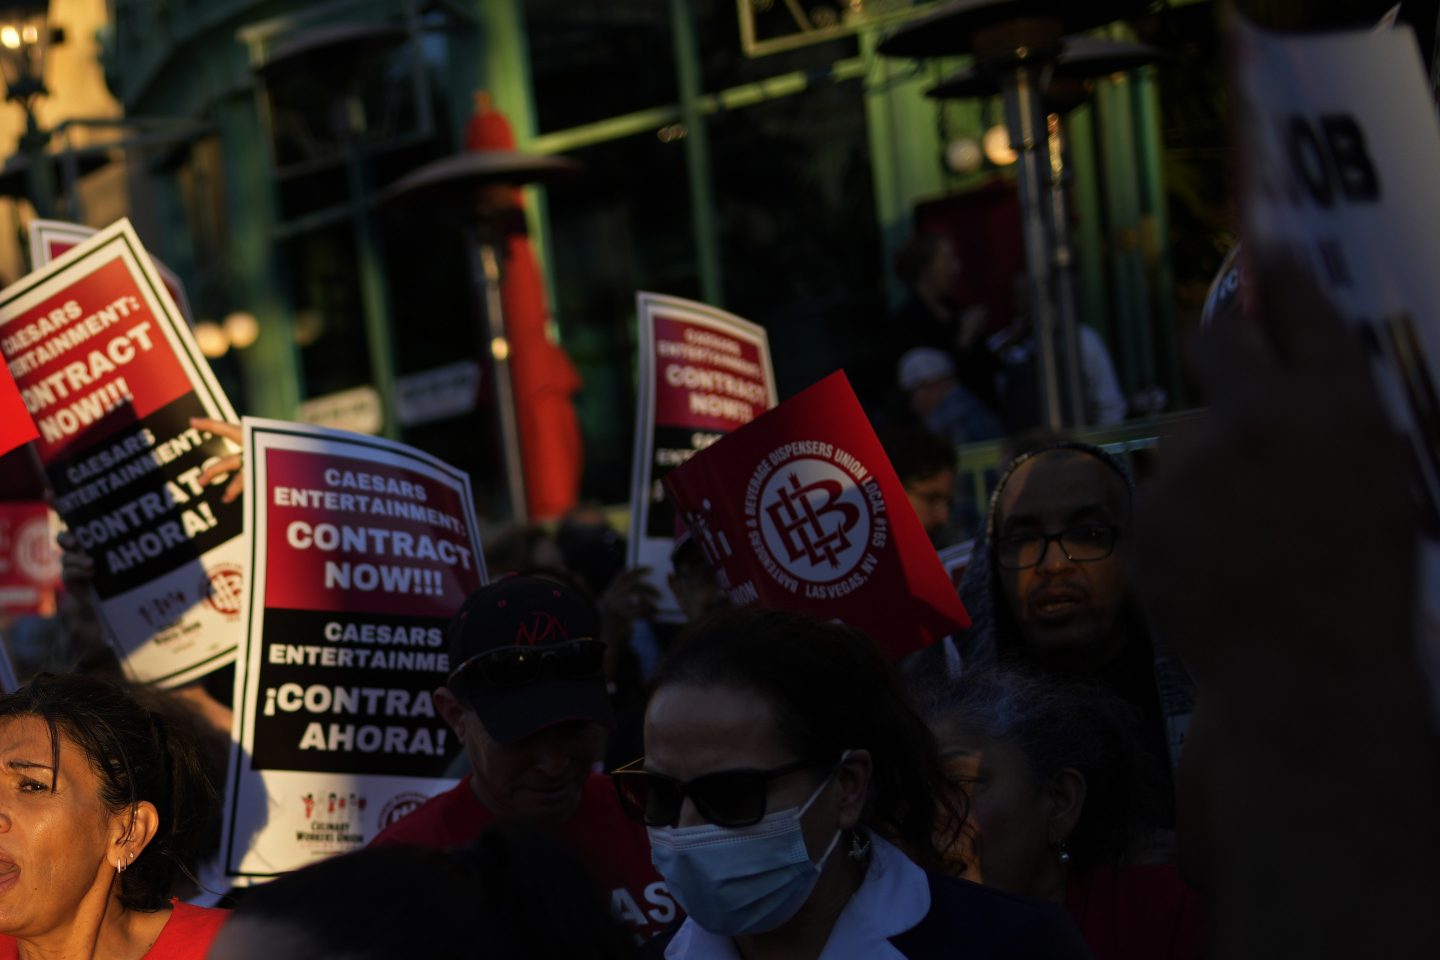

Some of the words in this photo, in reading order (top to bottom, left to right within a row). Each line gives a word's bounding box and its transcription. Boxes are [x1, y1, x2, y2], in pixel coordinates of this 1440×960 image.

[1290, 115, 1380, 207] OB
[22, 320, 154, 415] ONTRACT
[38, 376, 134, 444] NOW!!!
[66, 428, 157, 486] CAESARS
[768, 440, 834, 466] DISPENSERS
[834, 448, 868, 481] UNION
[861, 476, 886, 515] LOCAL
[73, 455, 232, 551] CONTRATO
[324, 467, 428, 503] CAESARS
[105, 500, 219, 576] AHORA!
[272, 485, 467, 539] ENTERTAINMENT:
[286, 520, 473, 572] CONTRACT
[324, 561, 445, 597] NOW!!!
[805, 583, 827, 600] LAS
[860, 553, 880, 576] NV
[268, 642, 451, 674] ENTERTAINME
[323, 620, 444, 648] CAESARS
[262, 682, 436, 720] ¡CONTRA
[298, 721, 448, 757] AHORA!
